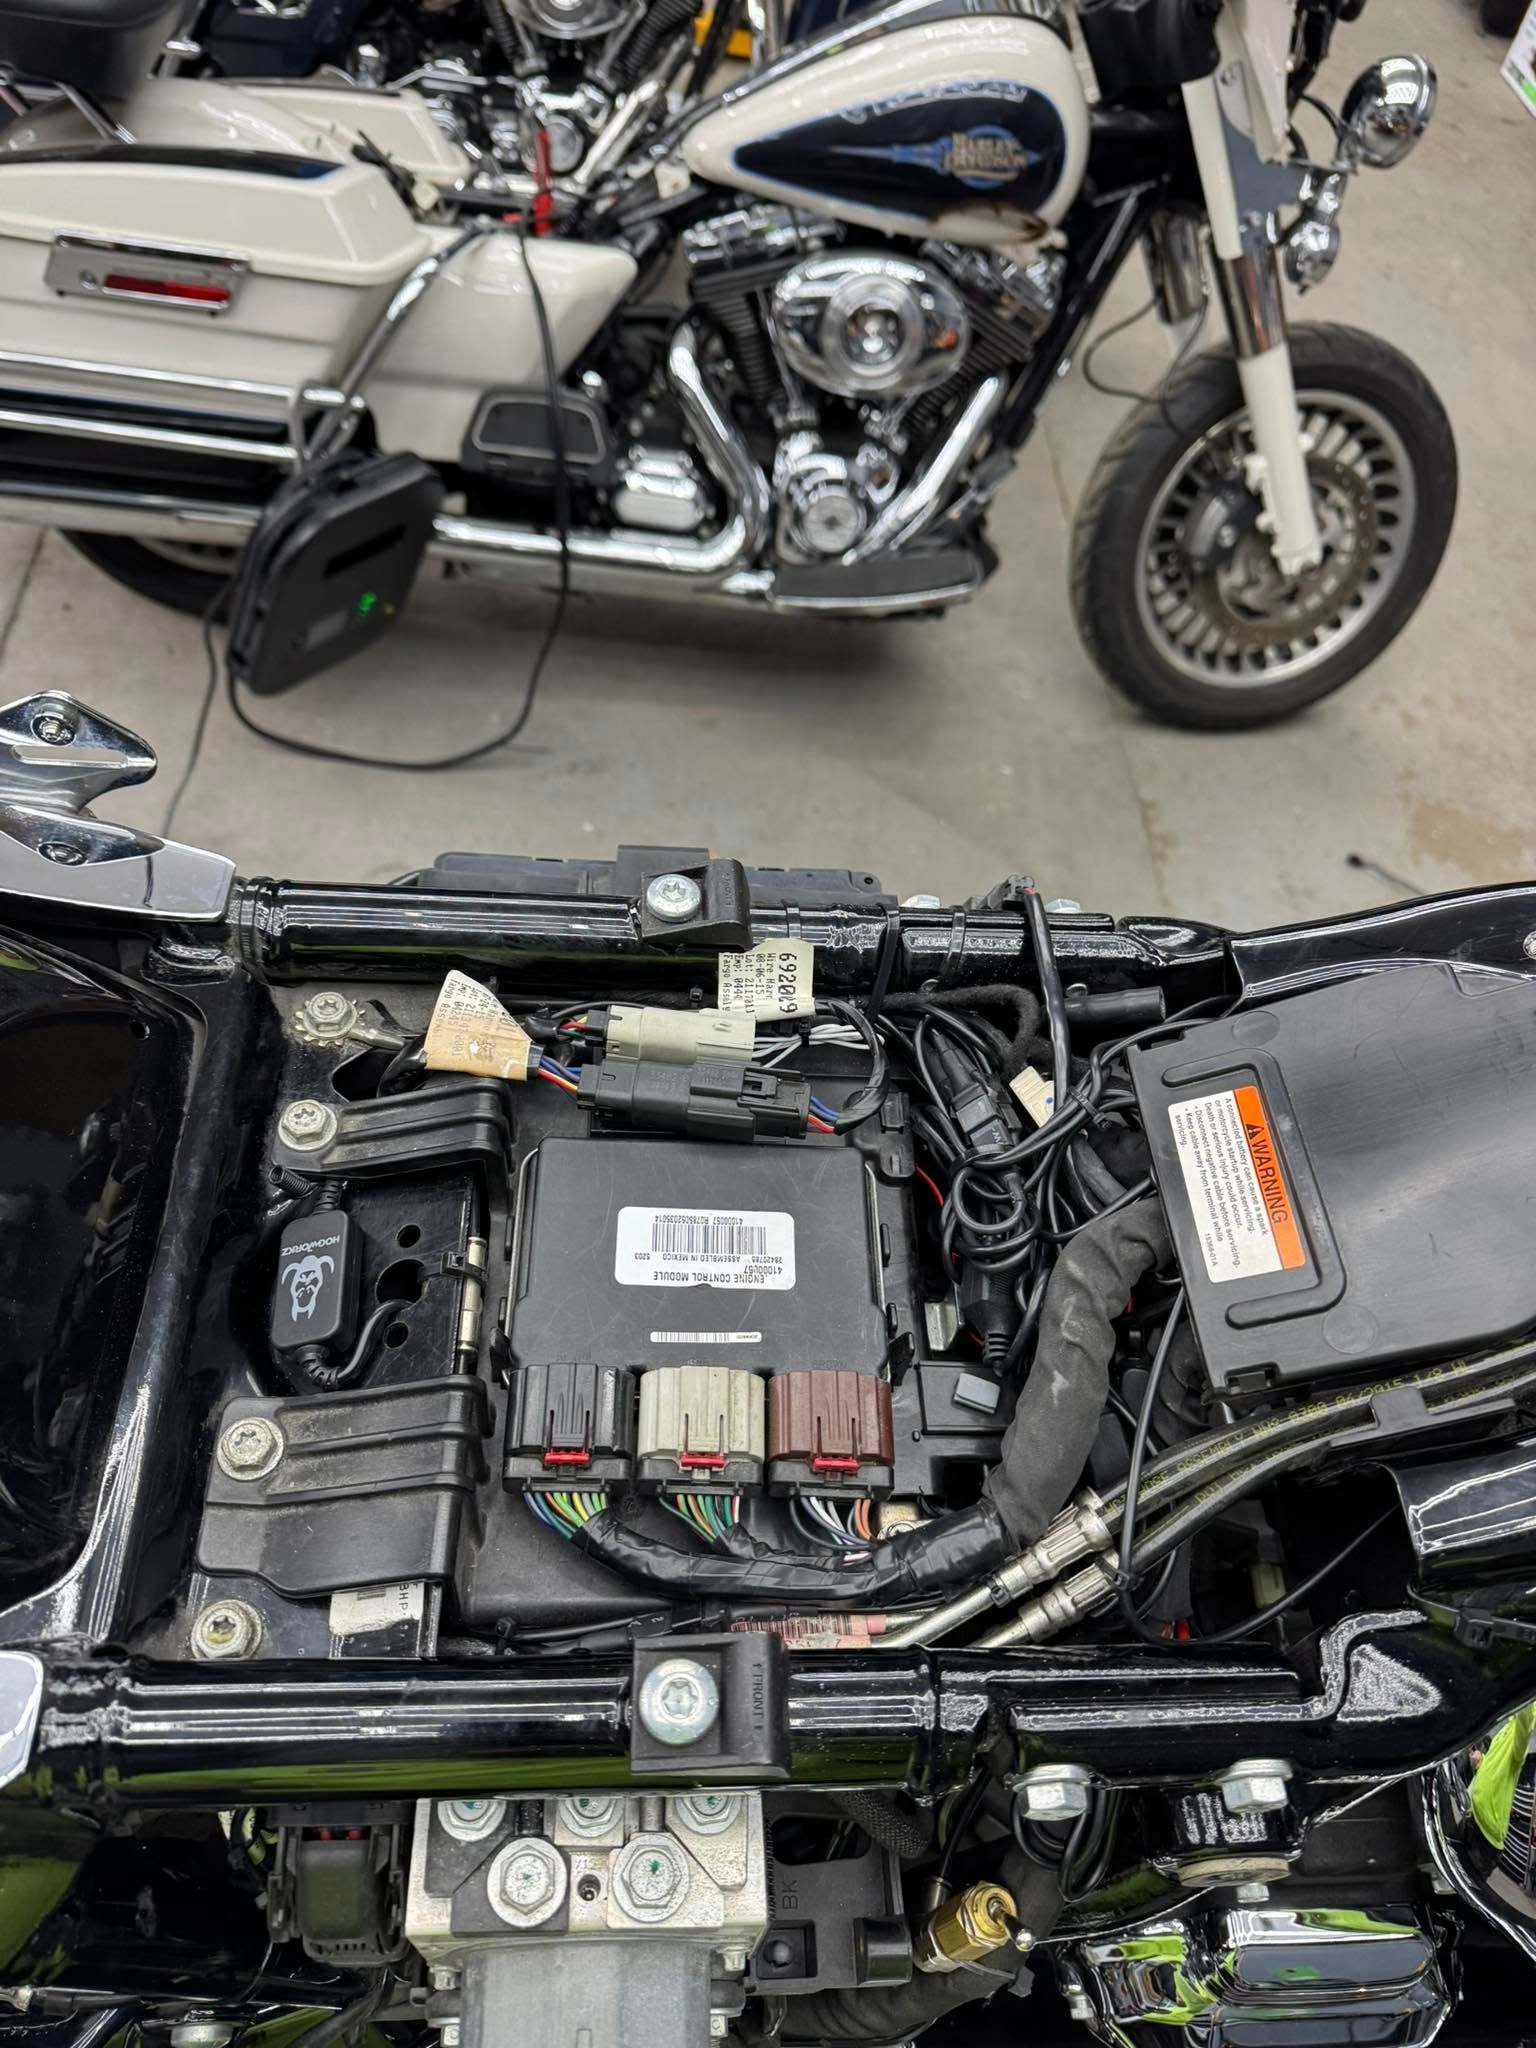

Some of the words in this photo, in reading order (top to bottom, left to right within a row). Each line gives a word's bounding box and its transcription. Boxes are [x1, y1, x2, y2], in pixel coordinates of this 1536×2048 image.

[723, 954, 732, 977] Fargo
[757, 953, 765, 994] 08-06-15
[767, 953, 775, 972] Wire
[1183, 1112, 1195, 1129] Keep
[1204, 1102, 1215, 1122] Death
[1226, 1104, 1242, 1140] connected
[1173, 1114, 1188, 1148] servicing.
[1188, 1129, 1200, 1149] cable
[1194, 1109, 1210, 1147] Disconnect
[1215, 1108, 1233, 1146] motorcycle
[1211, 1131, 1224, 1157] serious
[1235, 1140, 1249, 1165] battery
[1192, 1149, 1204, 1169] away
[1203, 1148, 1218, 1179] negative
[1217, 1158, 1230, 1180] injury
[1225, 1147, 1239, 1173] startup
[1198, 1169, 1209, 1187] from
[1234, 1173, 1246, 1194] while
[1243, 1166, 1252, 1181] can
[1251, 1138, 1288, 1224] WARNING
[1213, 1179, 1224, 1200] cable
[1225, 1180, 1236, 1202] could
[1247, 1181, 1259, 1205] cause
[1203, 1187, 1218, 1219] terminal
[1218, 1201, 1231, 1227] before
[1238, 1195, 1256, 1233] servicing.
[1231, 1204, 1243, 1228] occur.
[1255, 1212, 1268, 1236] spark
[1212, 1220, 1224, 1242] while
[700, 1254, 739, 1262] ASSEMBLED
[1224, 1228, 1242, 1268] servicing.
[653, 1271, 688, 1281] MODULE
[692, 1272, 730, 1282] CONTROL
[733, 1273, 764, 1283] ENGINE
[752, 1674, 763, 1718] FRONT
[782, 1879, 797, 1908] BK
